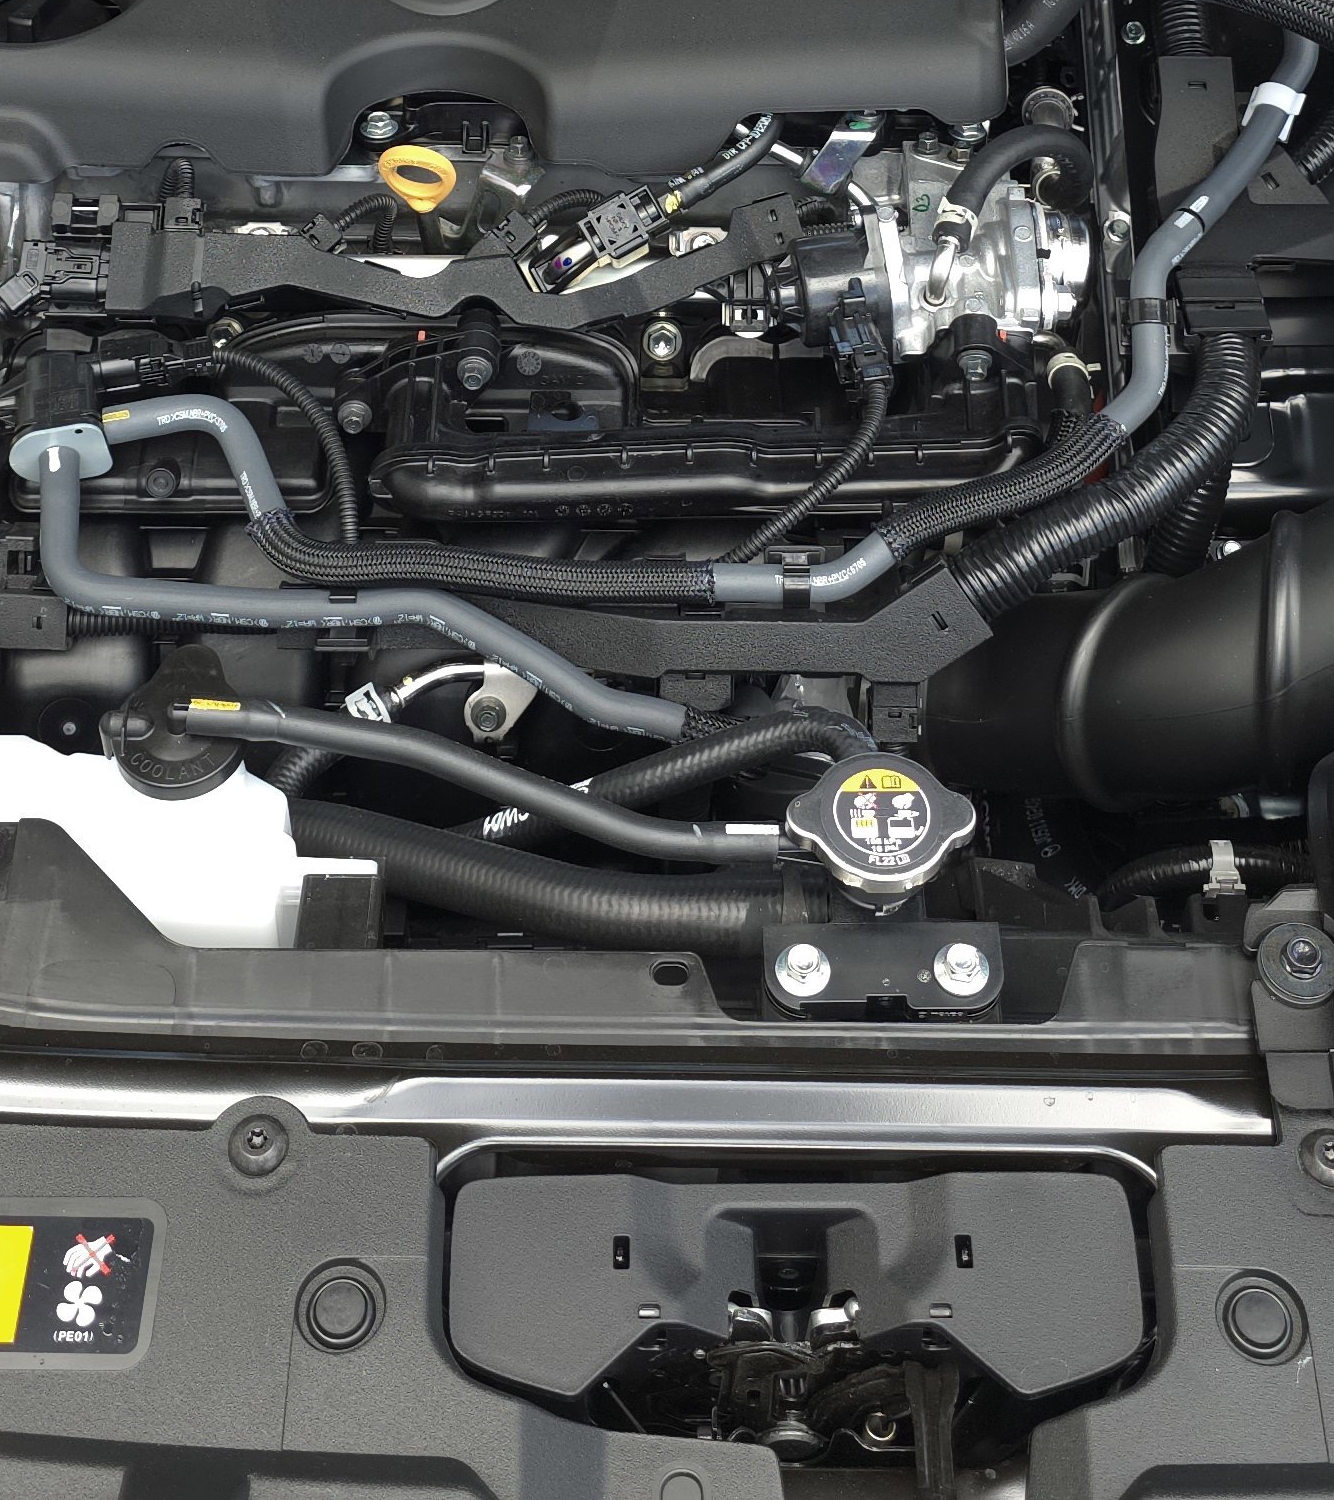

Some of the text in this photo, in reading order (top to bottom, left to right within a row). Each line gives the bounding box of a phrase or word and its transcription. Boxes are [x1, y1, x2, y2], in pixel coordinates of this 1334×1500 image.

[129, 752, 217, 781] COOLANT
[868, 854, 896, 866] FL22
[52, 1329, 94, 1344] (PE01)
